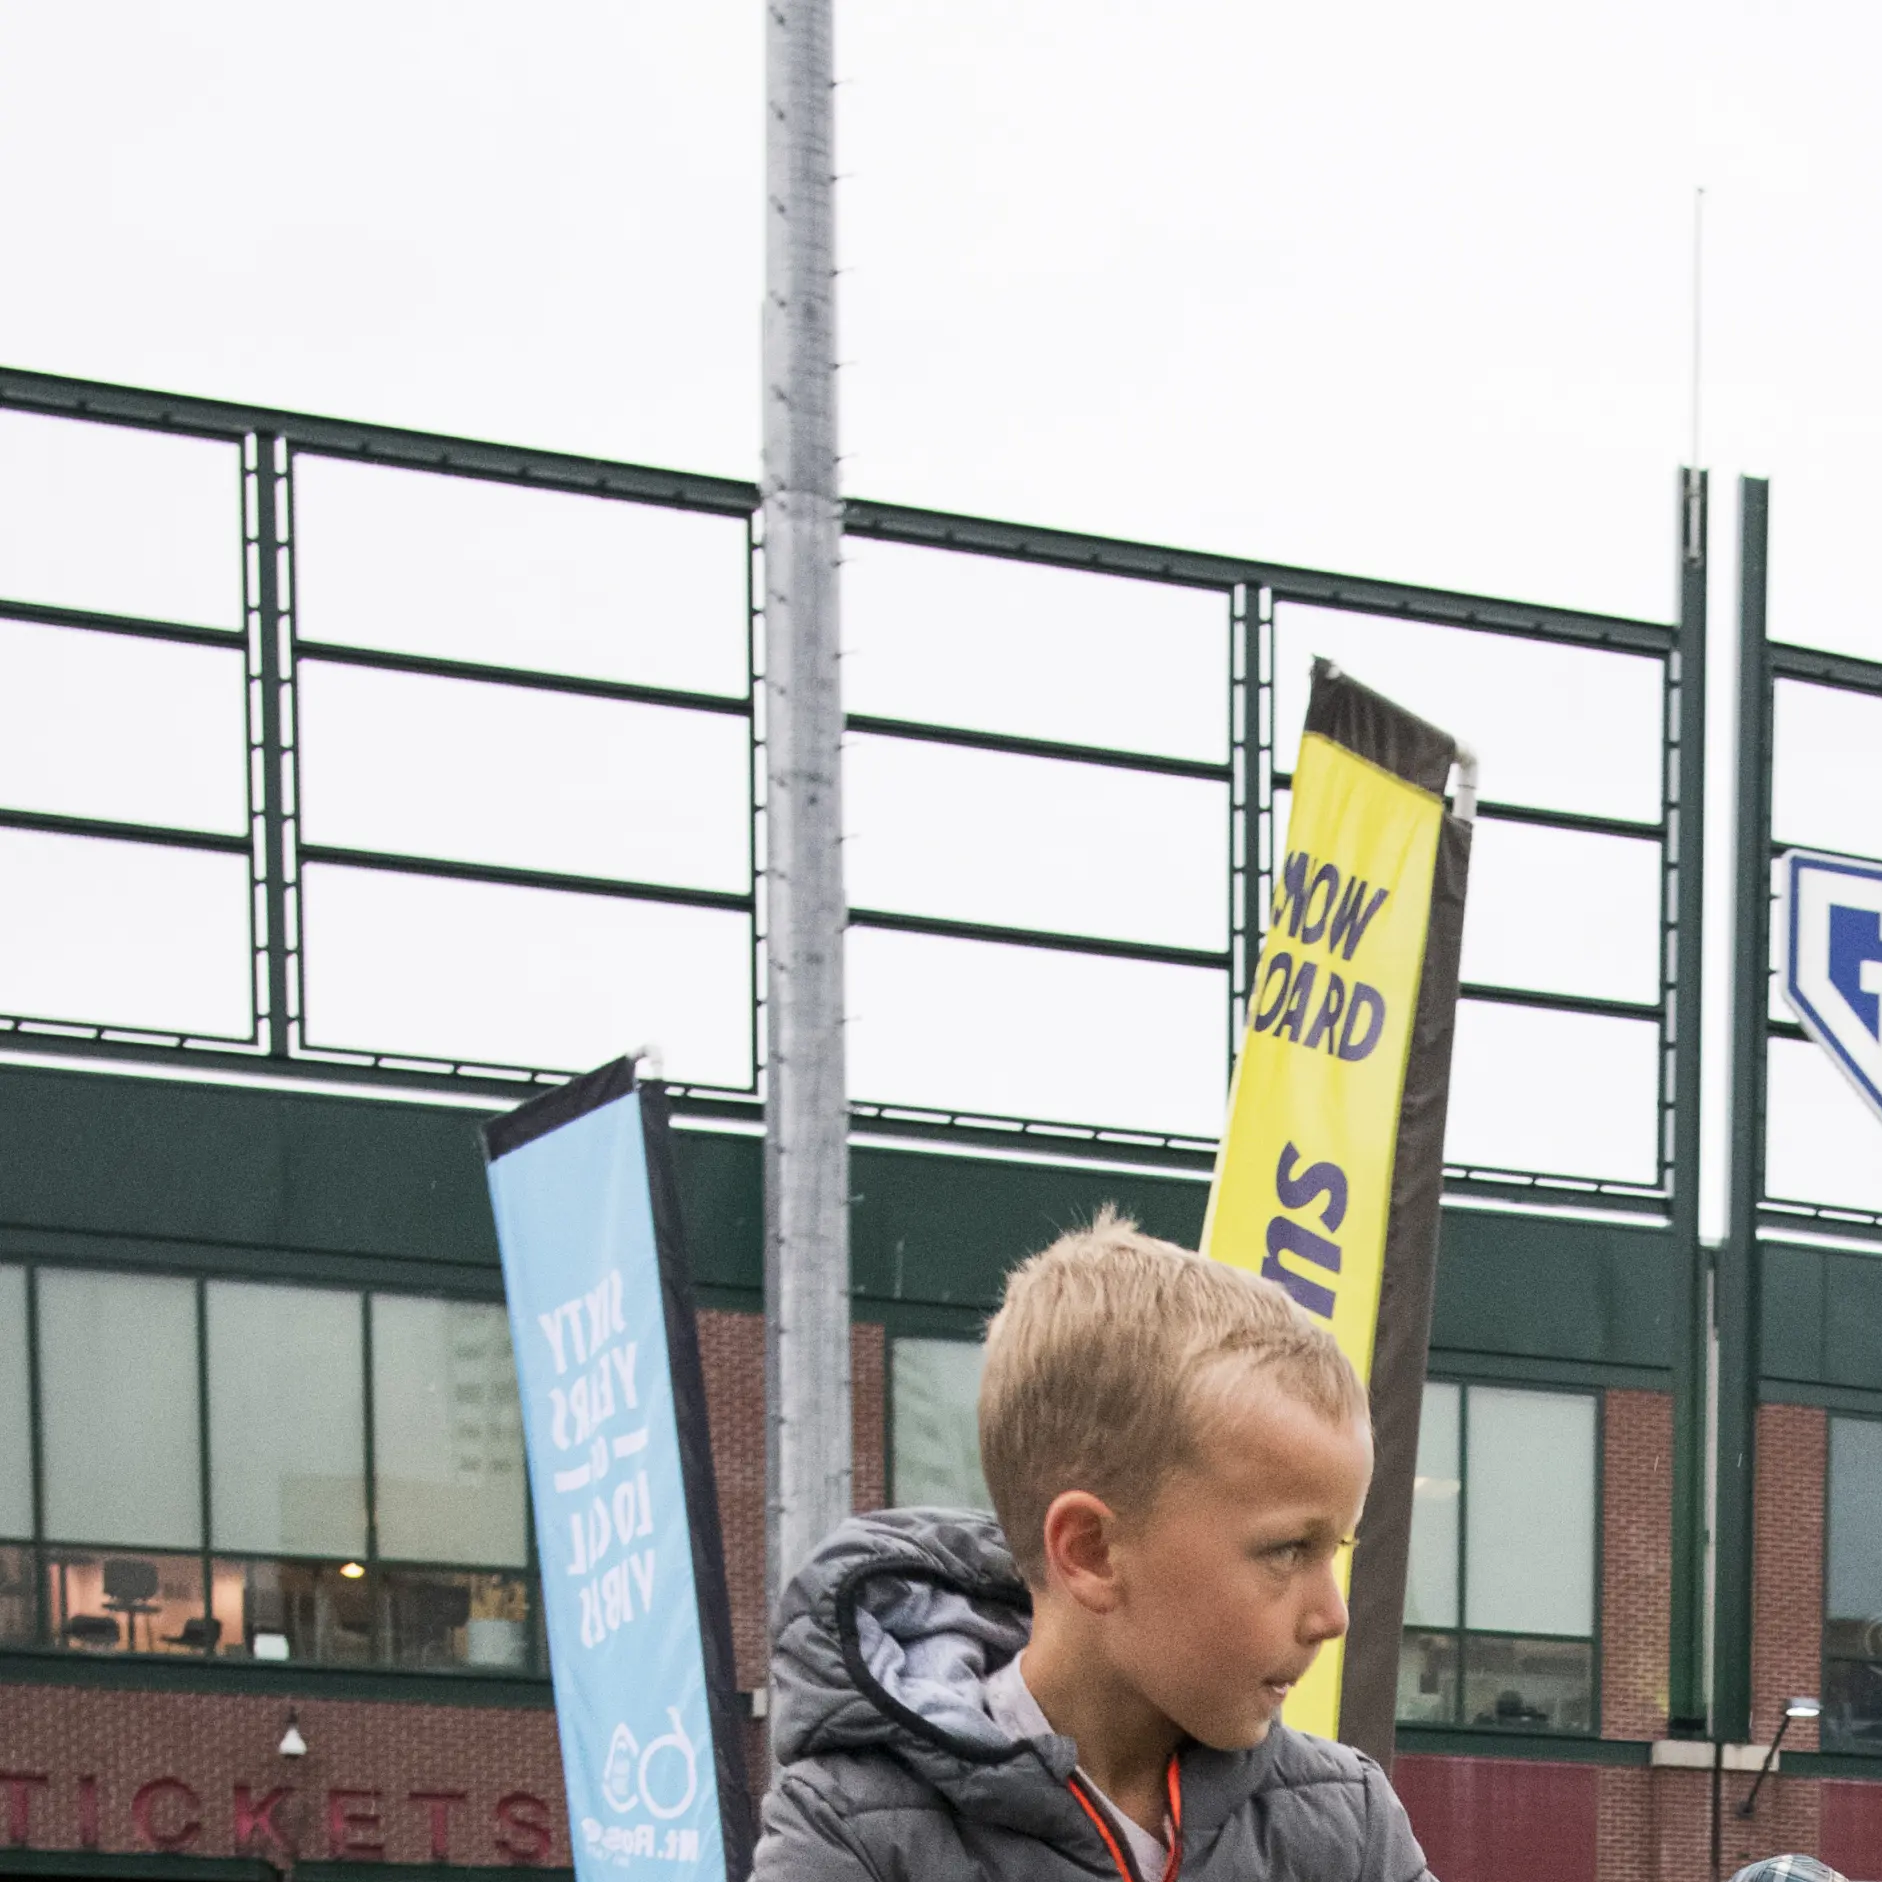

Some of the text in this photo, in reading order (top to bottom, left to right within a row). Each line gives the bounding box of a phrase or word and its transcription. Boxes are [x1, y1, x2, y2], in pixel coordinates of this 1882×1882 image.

[1272, 850, 1391, 961] NOW
[1252, 950, 1387, 1063] OARD
[0, 1771, 553, 1865] TICKETS
